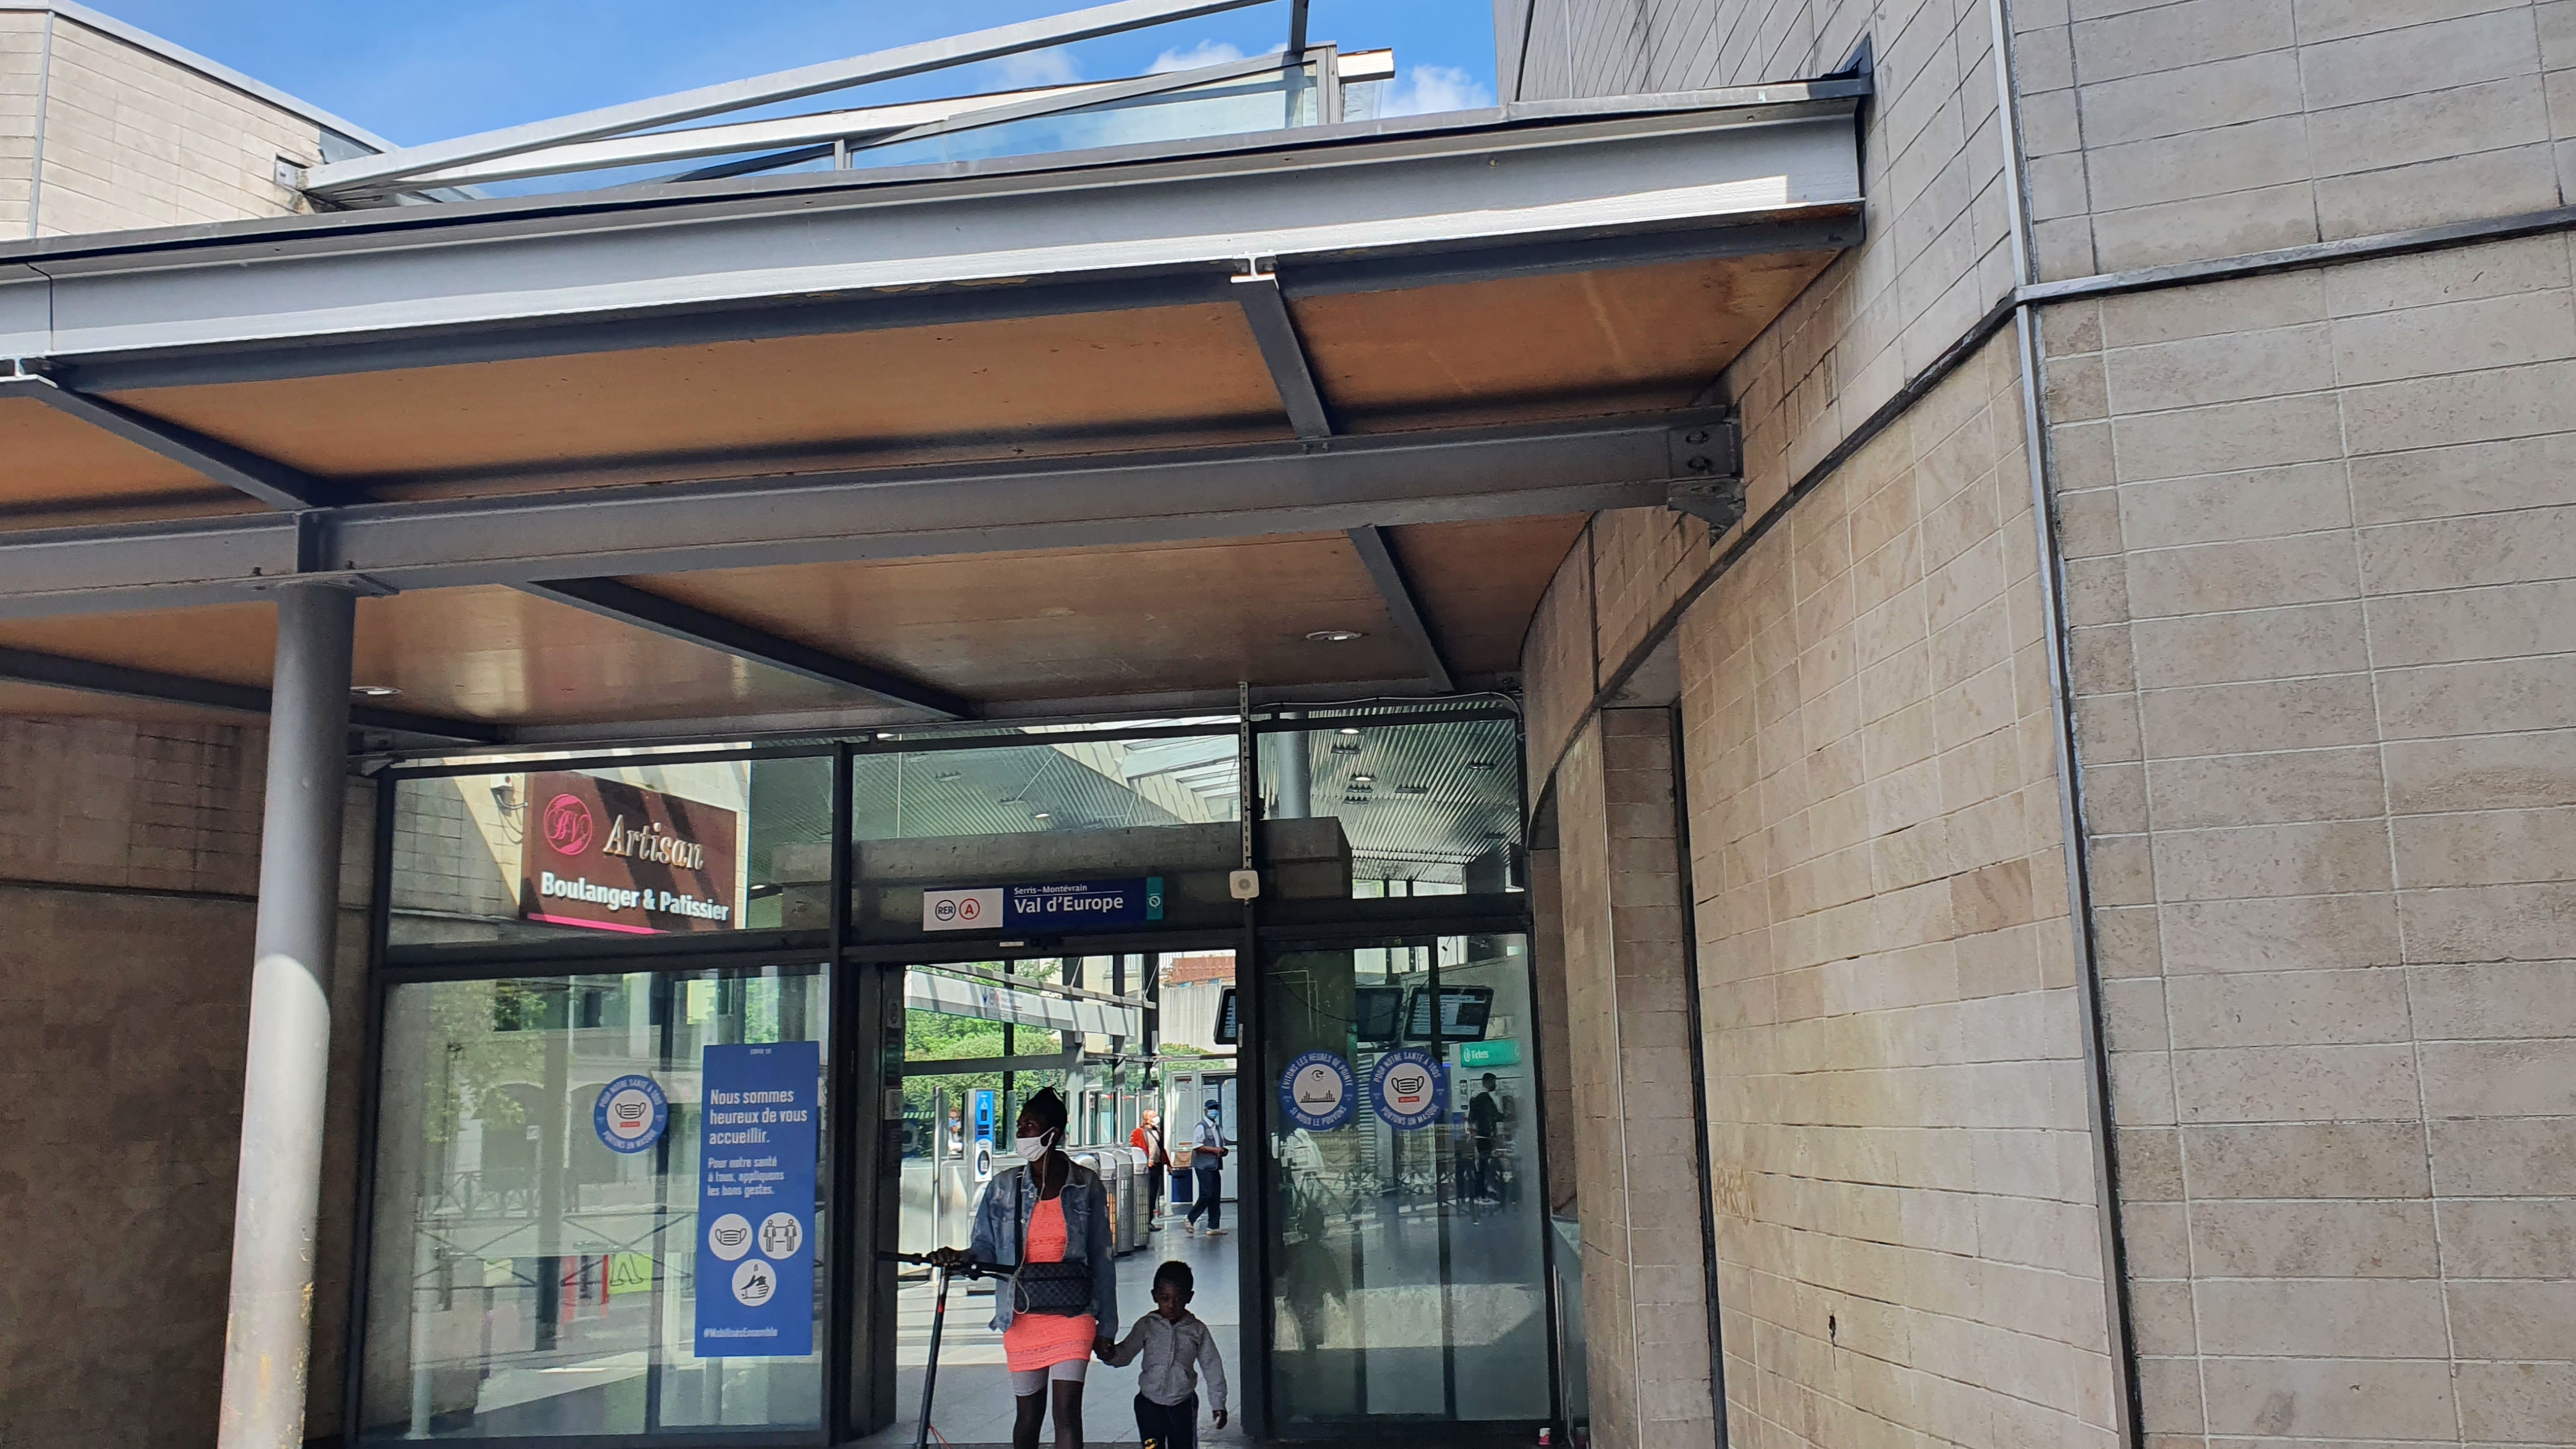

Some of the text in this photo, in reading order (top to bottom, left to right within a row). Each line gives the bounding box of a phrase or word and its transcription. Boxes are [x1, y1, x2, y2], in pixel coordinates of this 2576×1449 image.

[602, 814, 703, 870] Artisan
[541, 871, 730, 921] Boulanger & Patissier
[1015, 896, 1123, 914] Val d'Europe
[938, 903, 974, 915] RER A
[1373, 1066, 1386, 1083] POUR
[1383, 1053, 1402, 1068] NOTRE
[1428, 1062, 1441, 1078] TOUS
[710, 1089, 794, 1105] Nous sommes
[710, 1107, 808, 1125] heureux de vous
[1417, 1103, 1439, 1123] MASQUE
[709, 1127, 770, 1145] accueillir.
[707, 1157, 728, 1169] Pour
[707, 1184, 719, 1196] les
[721, 1184, 742, 1196] bons
